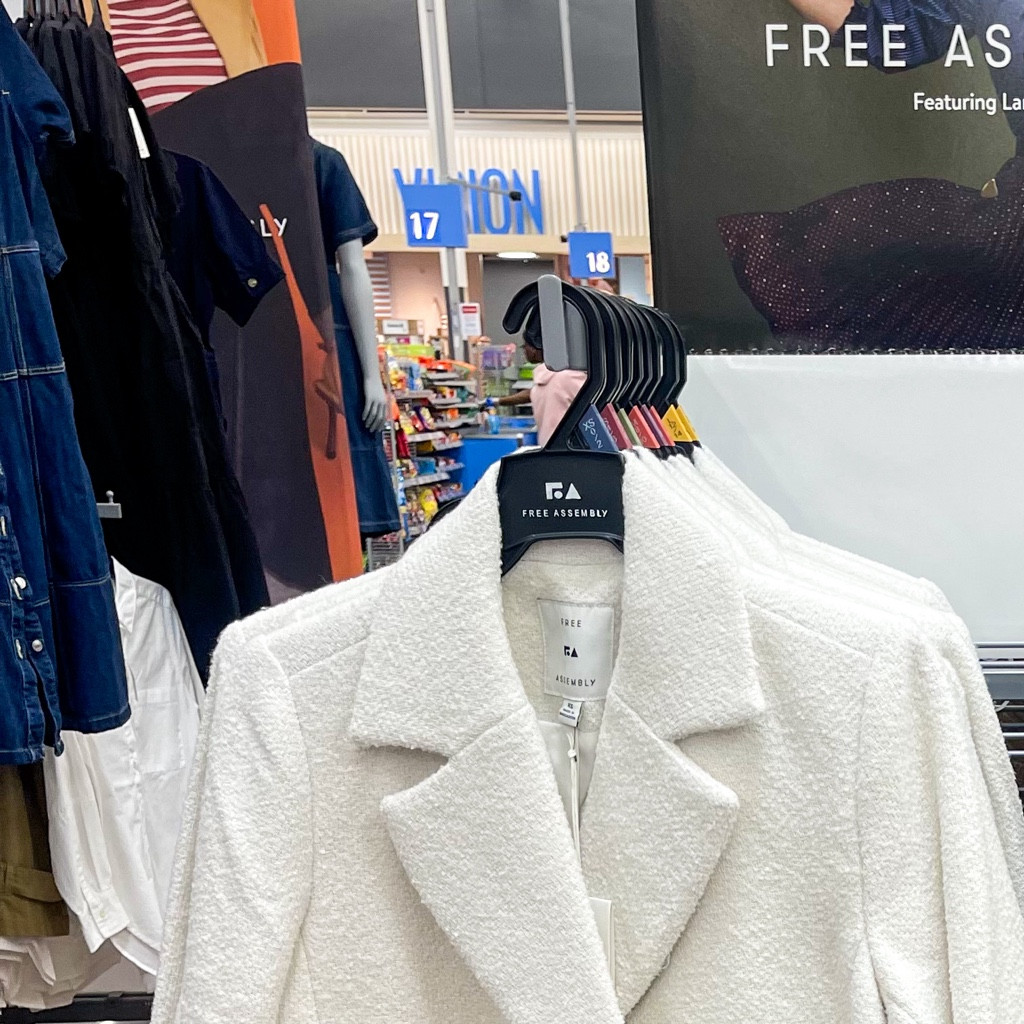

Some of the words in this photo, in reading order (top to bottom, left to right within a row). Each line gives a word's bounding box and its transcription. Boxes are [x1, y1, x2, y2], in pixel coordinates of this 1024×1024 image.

[764, 23, 908, 68] FREE
[913, 92, 997, 115] Featuring
[409, 211, 440, 240] 17
[586, 251, 611, 274] 18
[522, 509, 549, 518] FREE
[553, 509, 609, 518] ASSEMBLY
